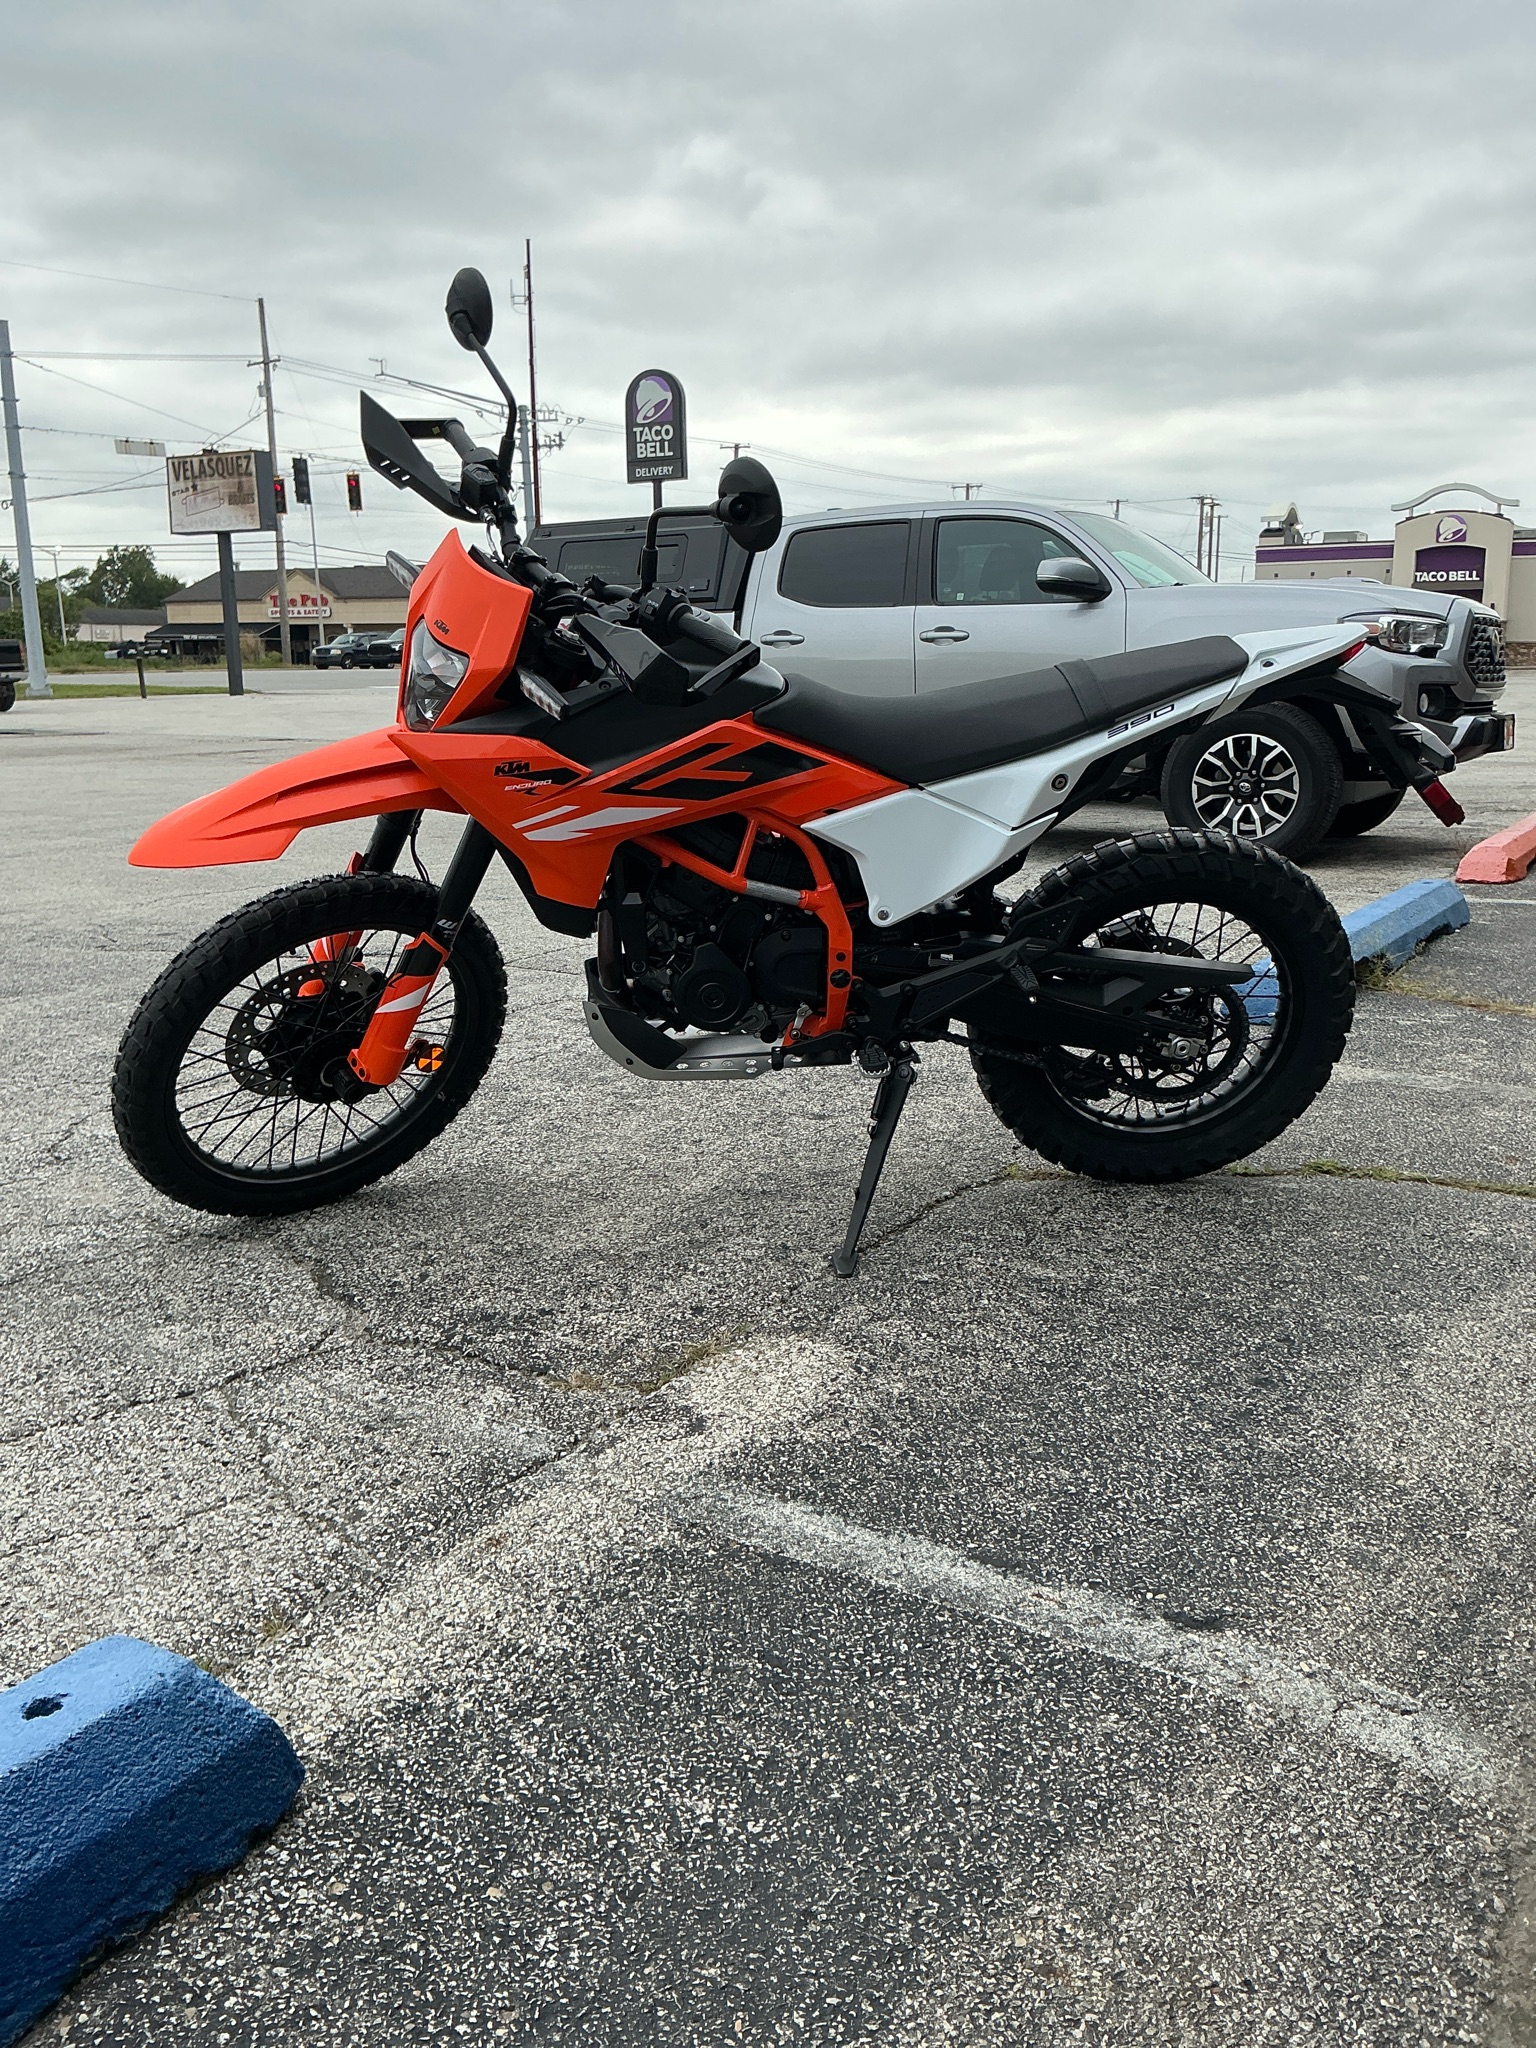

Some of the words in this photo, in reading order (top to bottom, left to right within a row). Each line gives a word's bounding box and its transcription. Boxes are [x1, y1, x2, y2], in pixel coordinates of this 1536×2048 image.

[633, 425, 673, 442] TACO
[637, 441, 673, 458] BELL
[172, 455, 252, 483] VELASQUEZ
[635, 466, 673, 477] DELIVERY
[1415, 571, 1447, 582] TACO
[1448, 570, 1480, 582] BELL
[269, 594, 297, 608] Te
[300, 593, 329, 607] Pub
[434, 619, 450, 635] KTM
[1107, 703, 1175, 739] 390
[494, 760, 531, 776] KTM
[504, 779, 552, 791] ENDURO
